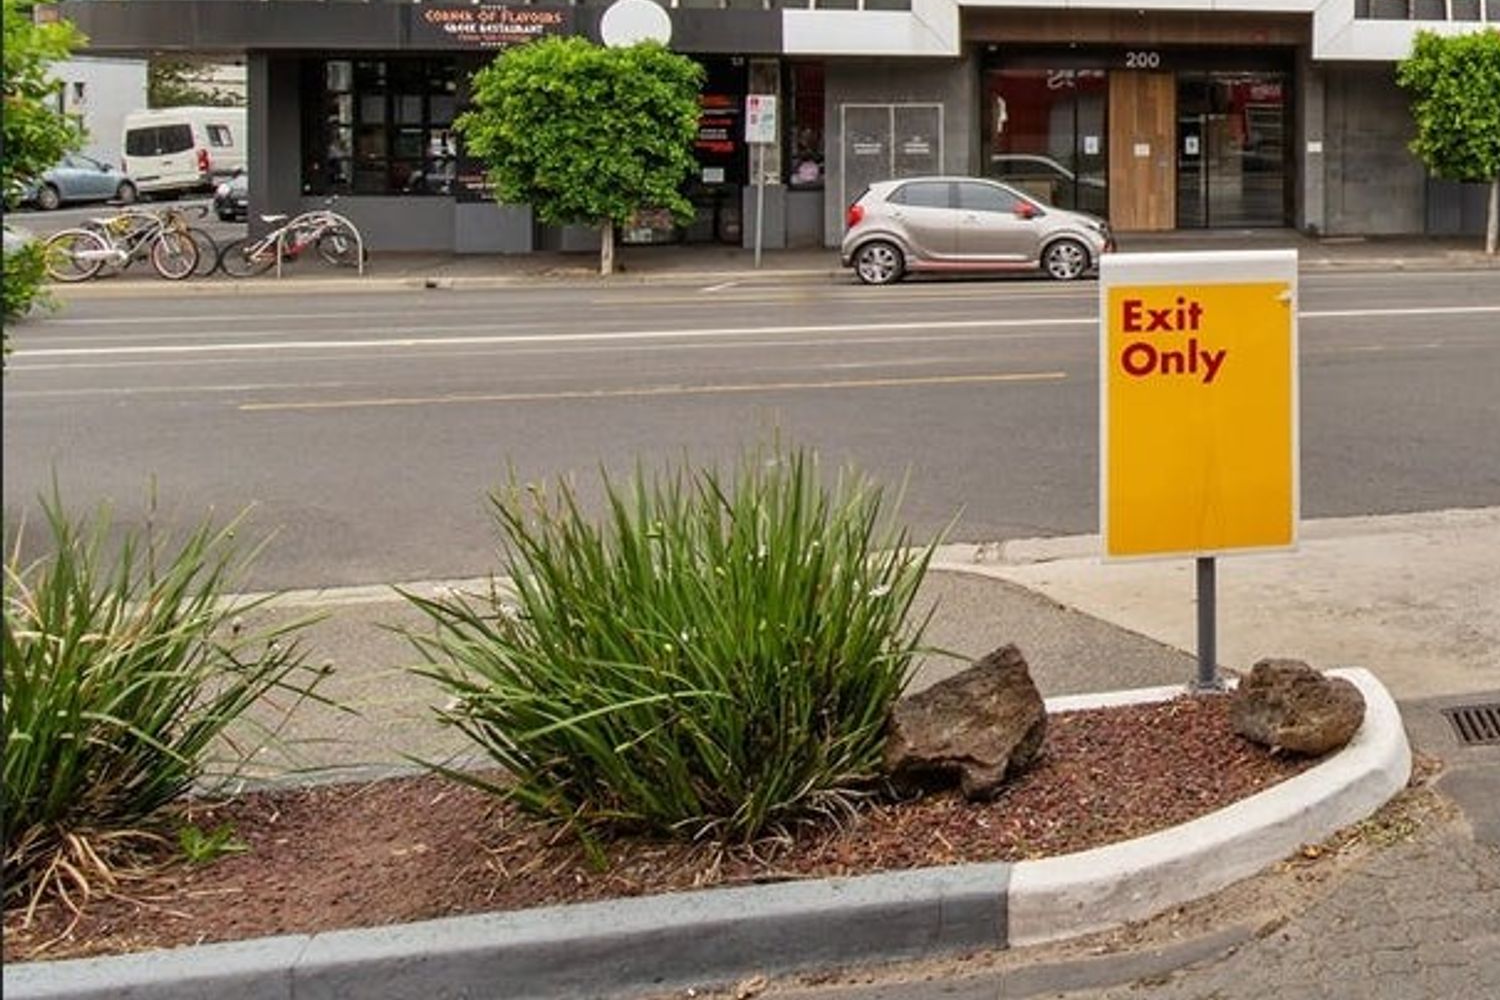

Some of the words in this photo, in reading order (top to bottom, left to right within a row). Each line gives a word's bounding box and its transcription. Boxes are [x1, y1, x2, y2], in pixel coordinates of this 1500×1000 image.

[477, 9, 496, 23] OF
[501, 10, 562, 24] FLAVOURS
[1125, 51, 1160, 68] 200
[1123, 296, 1203, 332] Exit
[1121, 339, 1227, 383] Only
